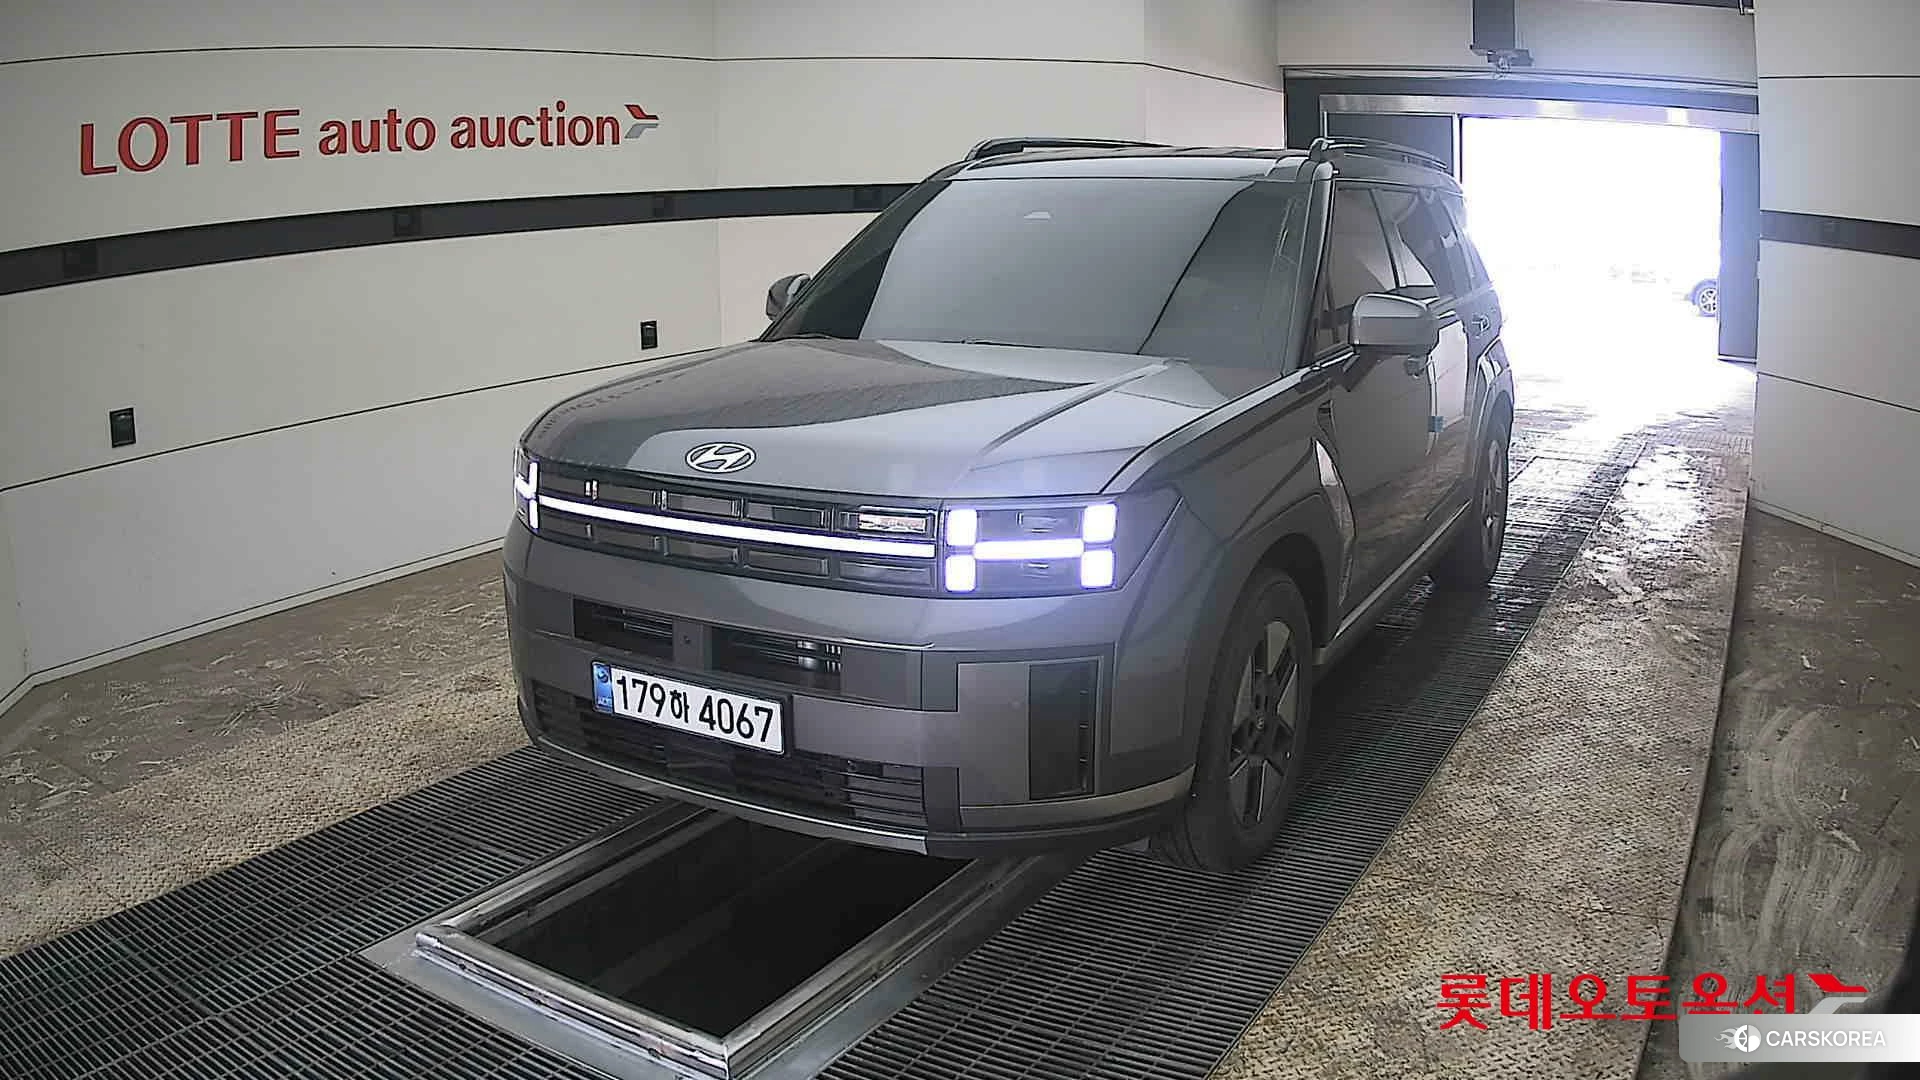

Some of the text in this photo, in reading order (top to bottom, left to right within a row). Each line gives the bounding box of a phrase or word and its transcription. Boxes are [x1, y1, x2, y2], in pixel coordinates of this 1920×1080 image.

[80, 100, 621, 176] LOTTE auto auction
[617, 676, 773, 742] 179하 4067
